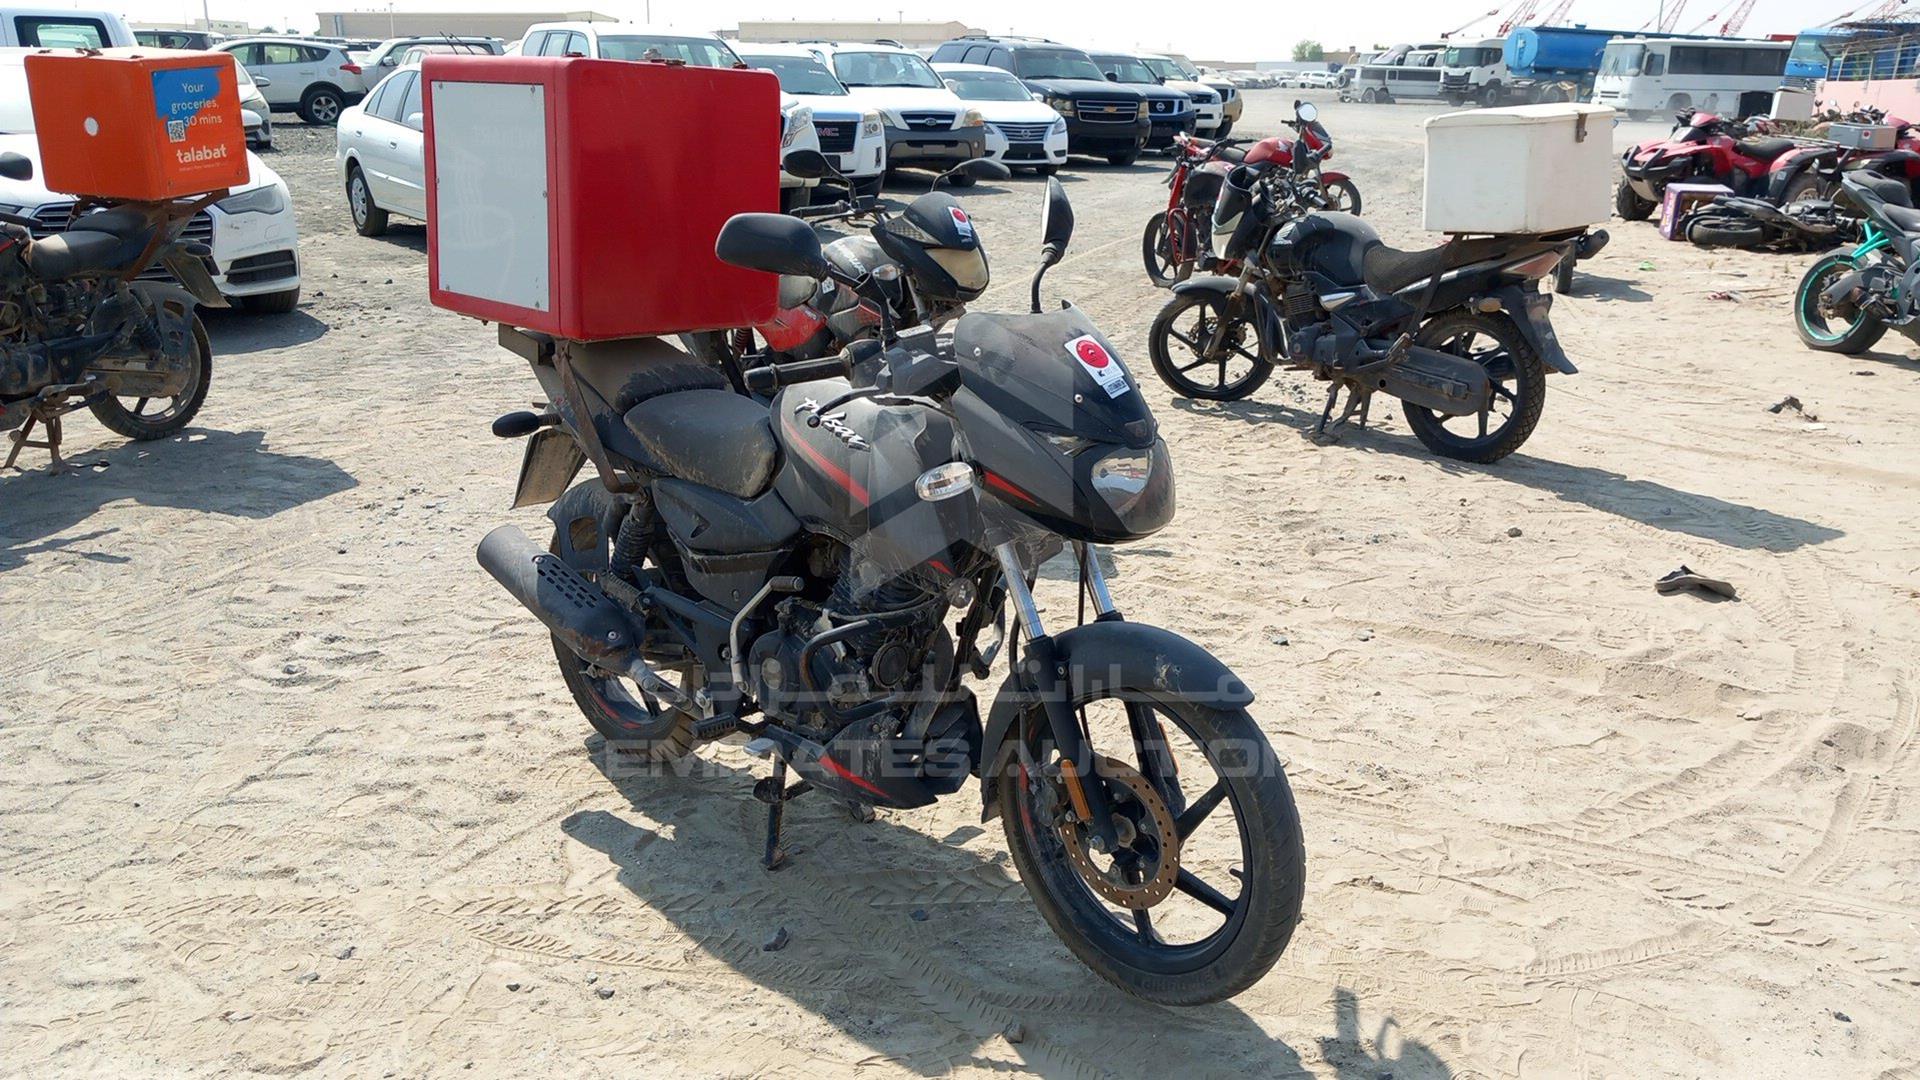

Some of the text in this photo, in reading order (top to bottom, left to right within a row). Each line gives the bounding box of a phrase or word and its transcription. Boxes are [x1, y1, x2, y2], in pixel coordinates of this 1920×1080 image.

[182, 83, 204, 93] Your
[171, 98, 219, 114] groceries,
[184, 114, 222, 127] 30 mins
[815, 127, 840, 136] MC
[176, 144, 227, 163] talabat
[795, 397, 871, 452] Plsar
